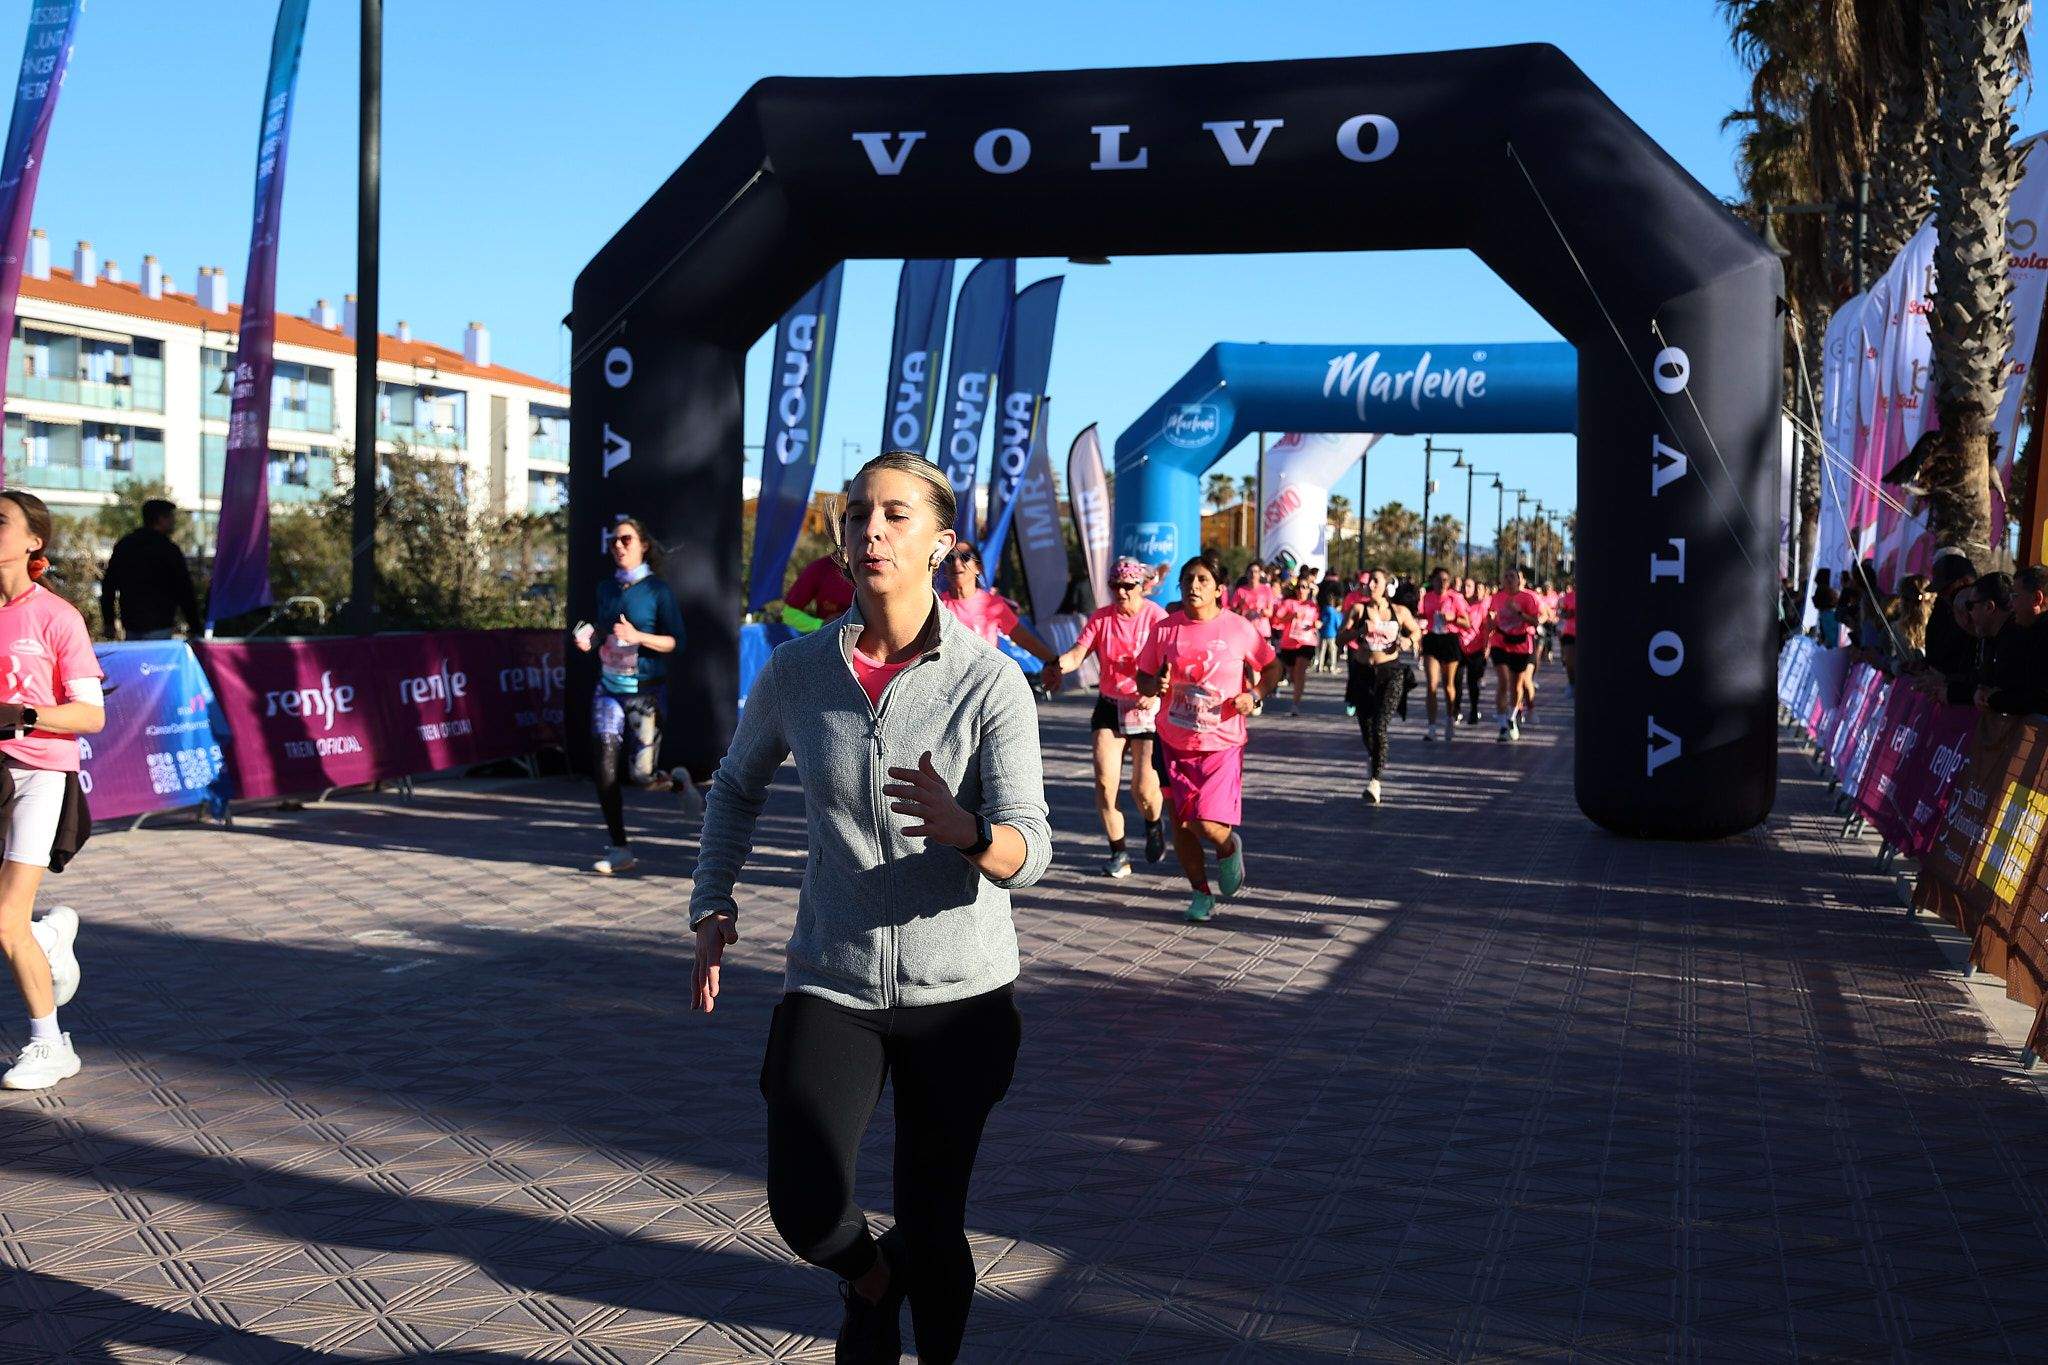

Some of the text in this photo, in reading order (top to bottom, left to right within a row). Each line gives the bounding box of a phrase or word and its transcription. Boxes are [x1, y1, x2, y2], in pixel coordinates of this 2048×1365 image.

[852, 113, 1399, 176] VOLVO
[777, 313, 818, 466] GOYA
[892, 351, 928, 448] OYA
[1323, 350, 1487, 422] Marlene
[946, 371, 987, 494] GOYA
[1647, 346, 1691, 778] VOLVO
[265, 670, 355, 731] renfe
[400, 657, 467, 714] renfe
[500, 652, 566, 703] renfe
[315, 735, 363, 757] OFICIAL
[1929, 732, 1968, 797] renfe
